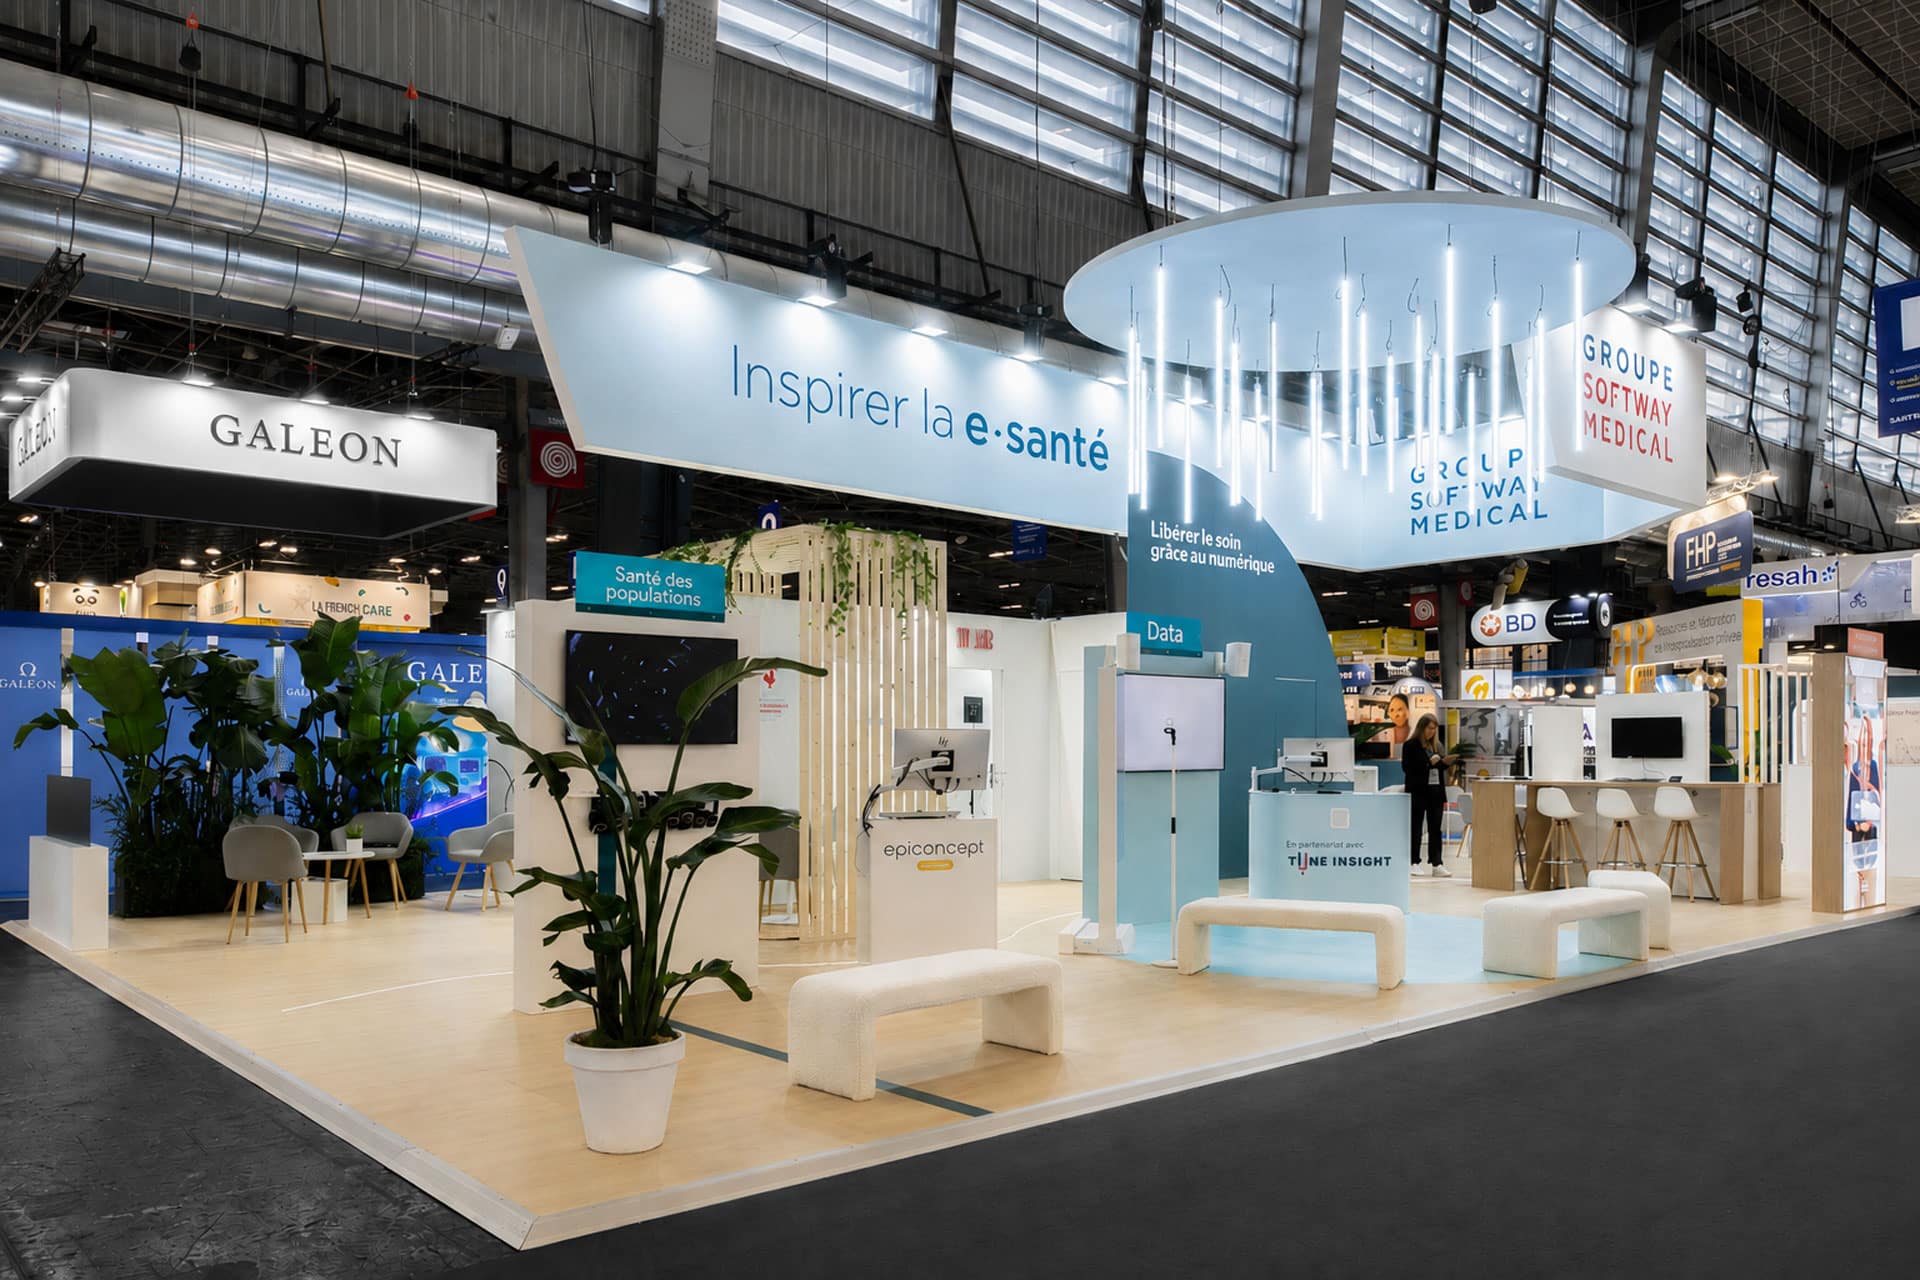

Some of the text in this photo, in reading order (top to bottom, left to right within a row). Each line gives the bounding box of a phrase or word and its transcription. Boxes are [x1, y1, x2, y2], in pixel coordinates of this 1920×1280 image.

[1583, 334, 1673, 392] GROUPE
[733, 344, 909, 429] Inspirer
[923, 387, 953, 439] la
[1583, 372, 1672, 427] SOFTWAY
[210, 414, 402, 468] GALEON
[1583, 410, 1673, 463] MEDICAL
[1410, 448, 1524, 484] GROUP
[1410, 500, 1548, 536] MEDICAL
[1151, 520, 1241, 550] Libérer le soin
[1150, 543, 1275, 576] grâce au numérique
[1685, 531, 1717, 569] FHP
[615, 566, 693, 588] Santé des
[1746, 564, 1817, 588] resah
[606, 586, 702, 607] populations
[312, 601, 392, 617] LA FRENCH CARE
[1147, 620, 1184, 643] Data
[1506, 613, 1536, 633] BD
[0, 679, 56, 689] GALEON
[407, 661, 483, 684] GALE
[883, 840, 984, 860] epiconcept
[1286, 840, 1297, 849] En
[1298, 840, 1344, 850] partenariat
[1332, 856, 1392, 867] INSIGHT
